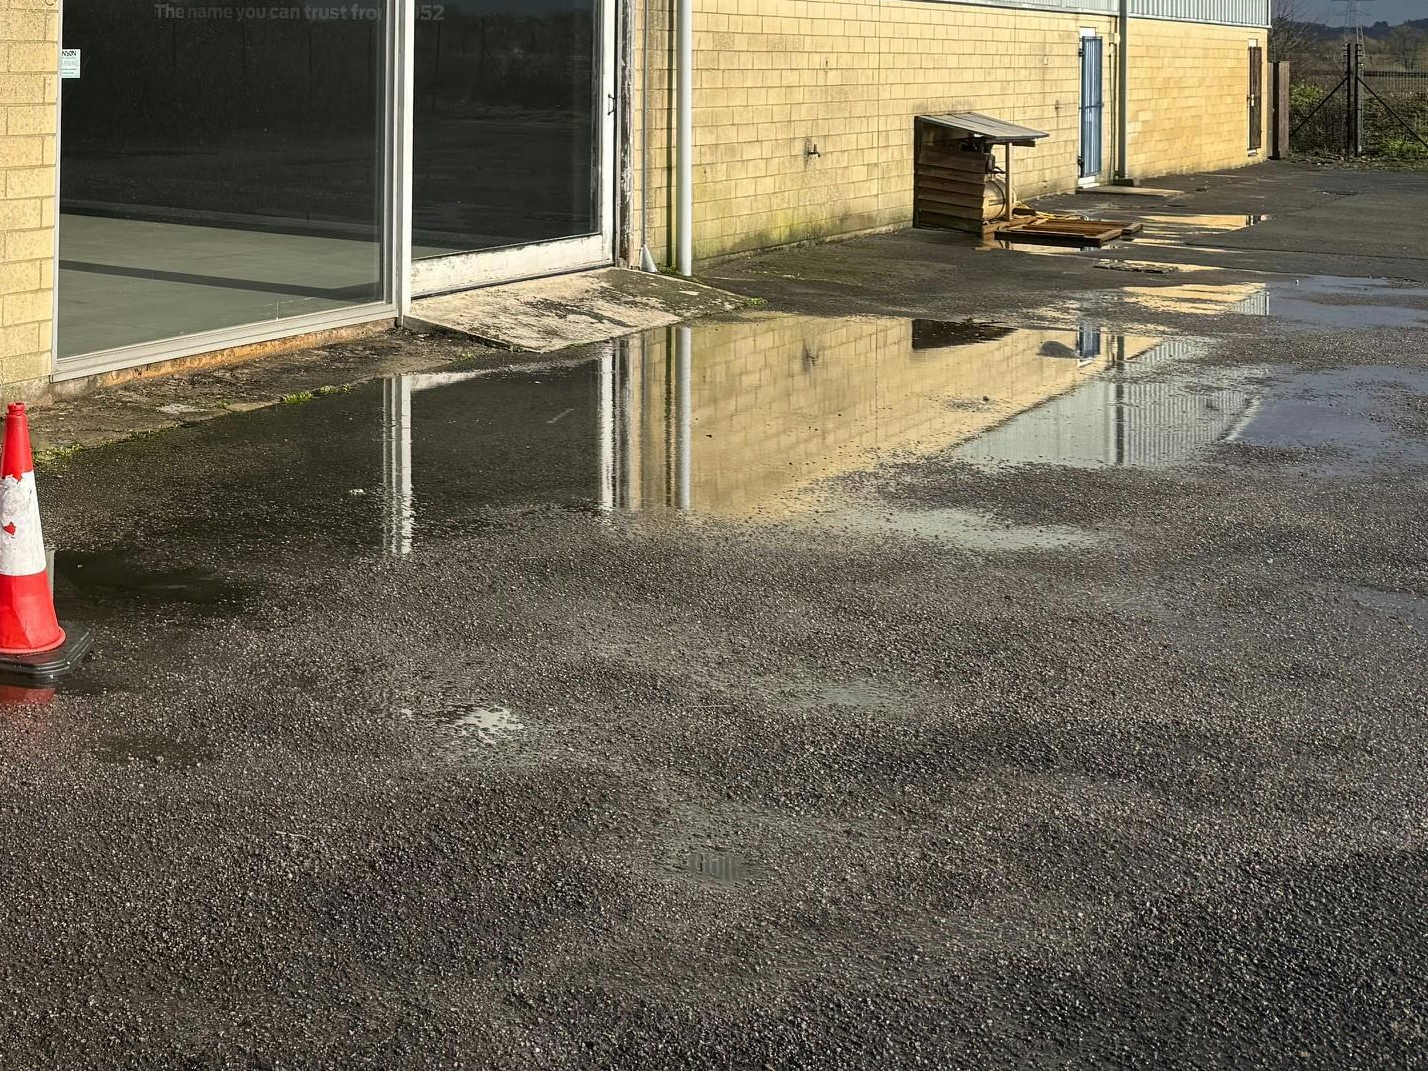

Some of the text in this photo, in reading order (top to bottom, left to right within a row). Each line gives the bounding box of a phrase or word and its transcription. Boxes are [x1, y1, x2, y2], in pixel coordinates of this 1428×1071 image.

[154, 3, 184, 19] The
[187, 6, 232, 19] name
[235, 6, 267, 22] you
[270, 6, 300, 19] can
[304, 4, 348, 20] trust
[350, 3, 382, 20] fro
